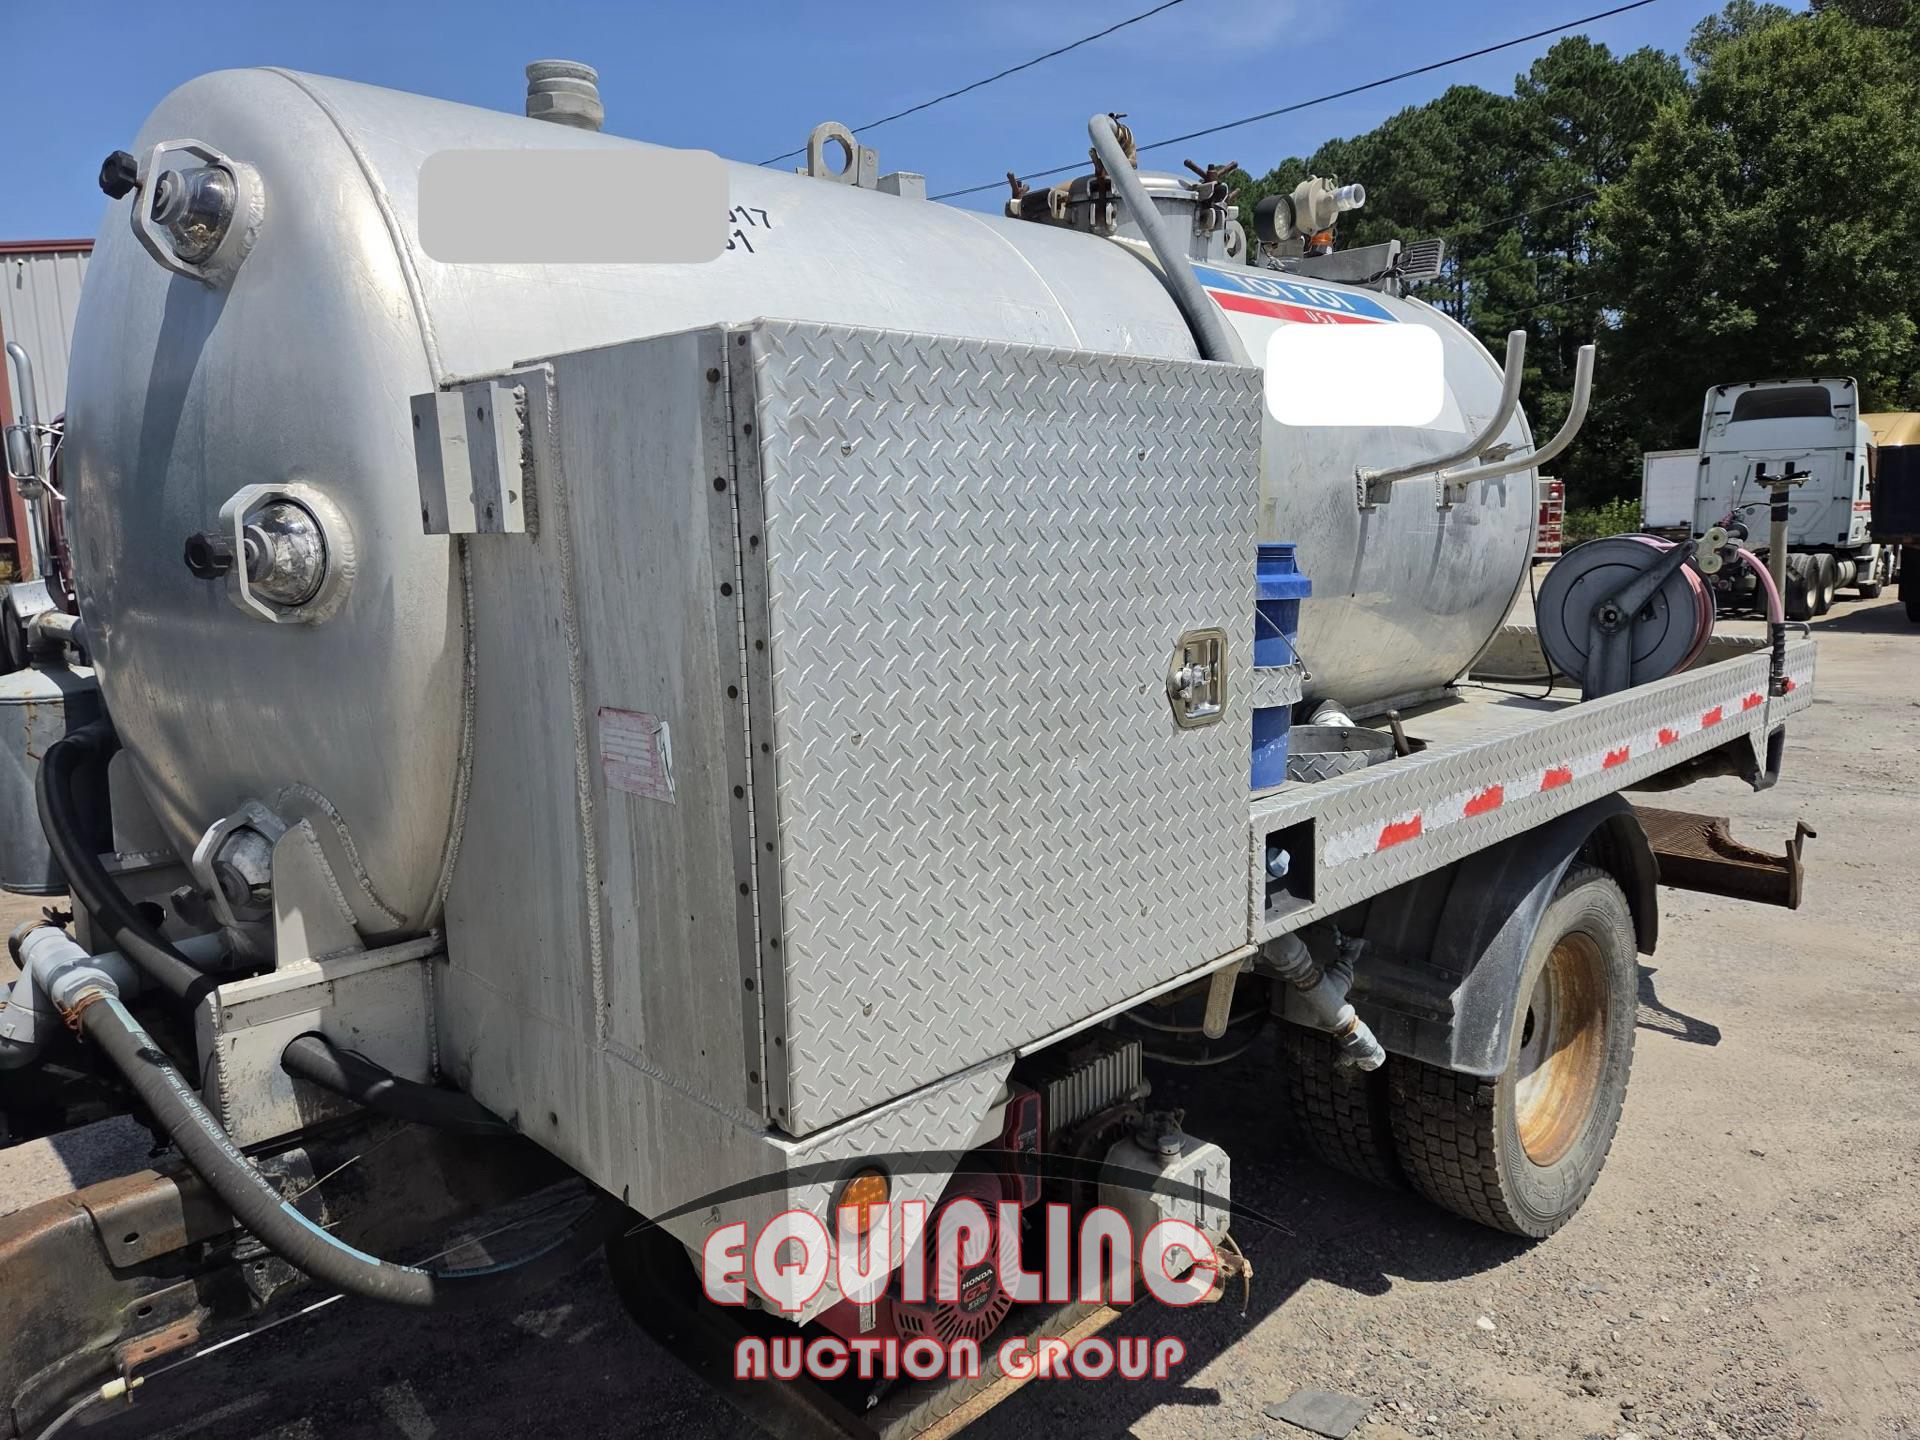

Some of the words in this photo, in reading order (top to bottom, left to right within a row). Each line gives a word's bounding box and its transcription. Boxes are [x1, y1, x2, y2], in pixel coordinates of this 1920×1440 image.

[1223, 273, 1296, 299] TOI
[1287, 285, 1356, 311] TOI
[1303, 309, 1340, 325] USA
[961, 1268, 993, 1290] HONDA
